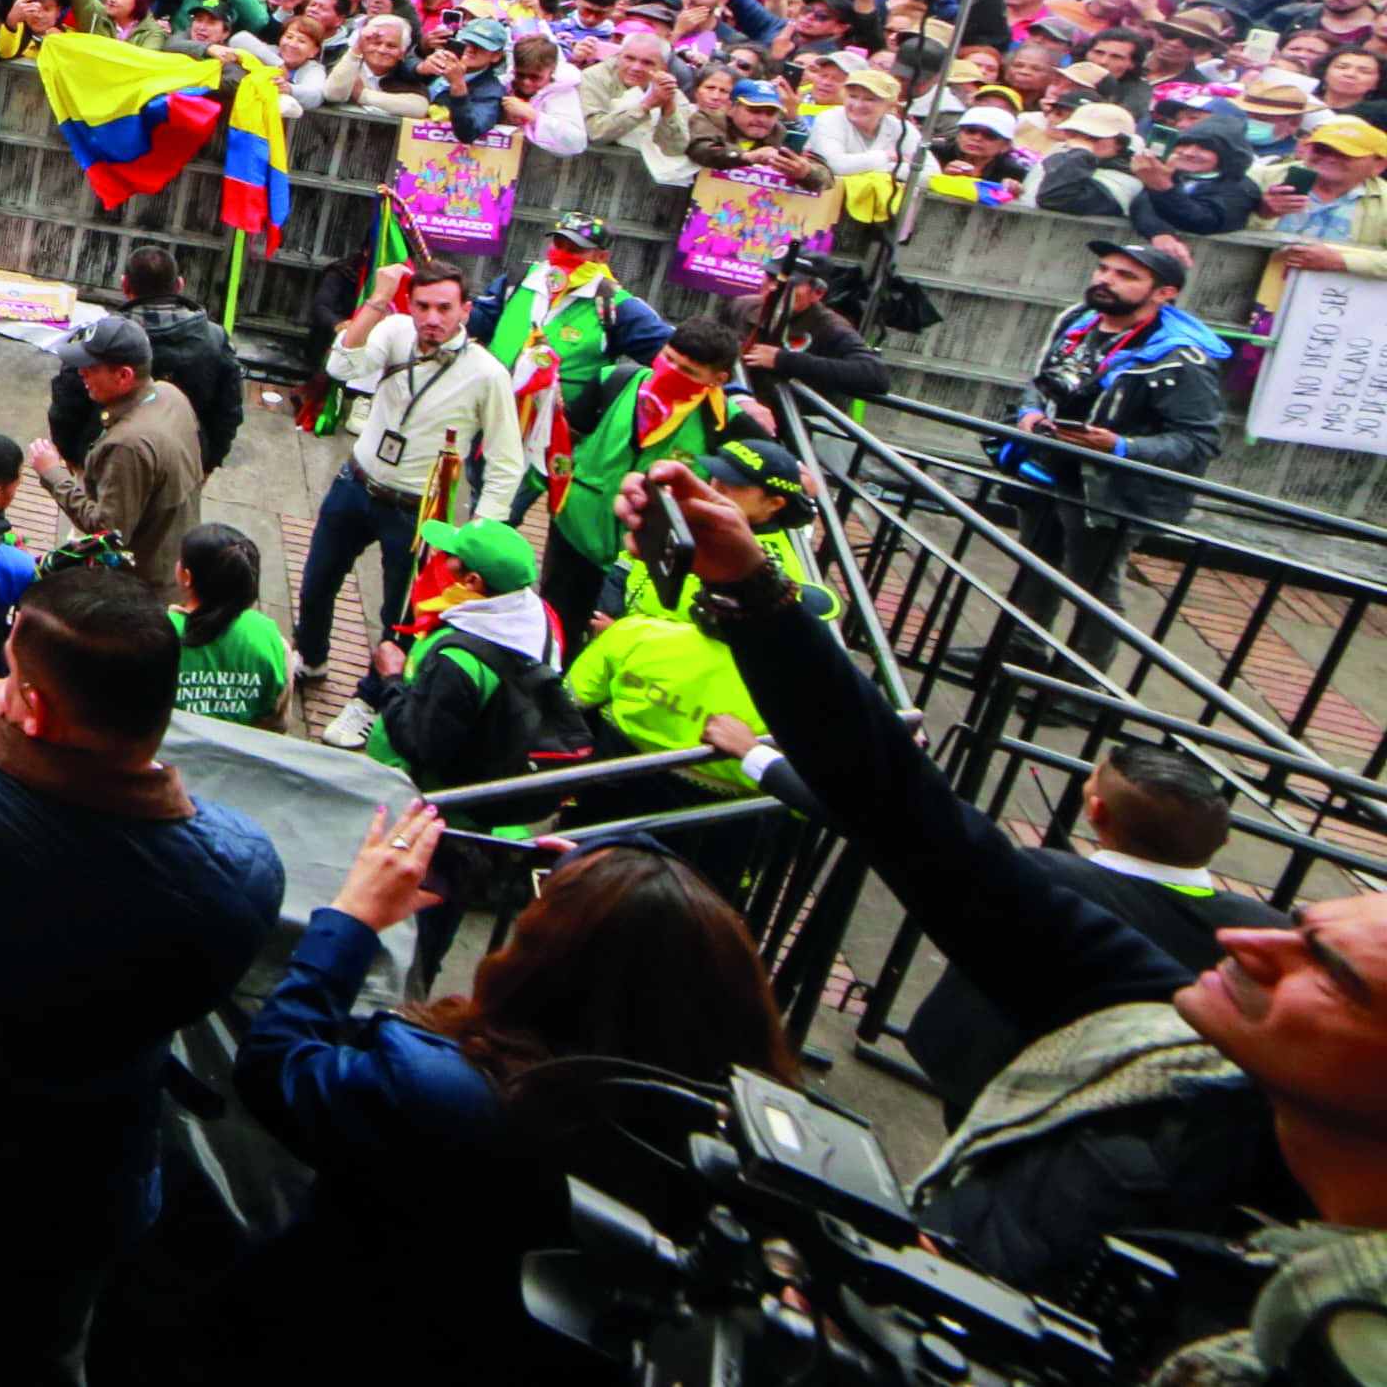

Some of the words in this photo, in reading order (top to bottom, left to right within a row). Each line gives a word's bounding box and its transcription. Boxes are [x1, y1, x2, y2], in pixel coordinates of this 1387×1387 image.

[431, 216, 494, 231] MARZO
[720, 258, 767, 276] MAR
[1318, 286, 1354, 317] SER
[1331, 336, 1374, 398] ESCLAVO
[1291, 374, 1323, 397] NO
[1280, 402, 1314, 427] YO
[1320, 402, 1353, 432] MAS
[1352, 416, 1382, 439] YO
[179, 670, 262, 687] GUARDIA
[176, 686, 260, 701] INDIGENA
[187, 699, 248, 714] TOLIMA
